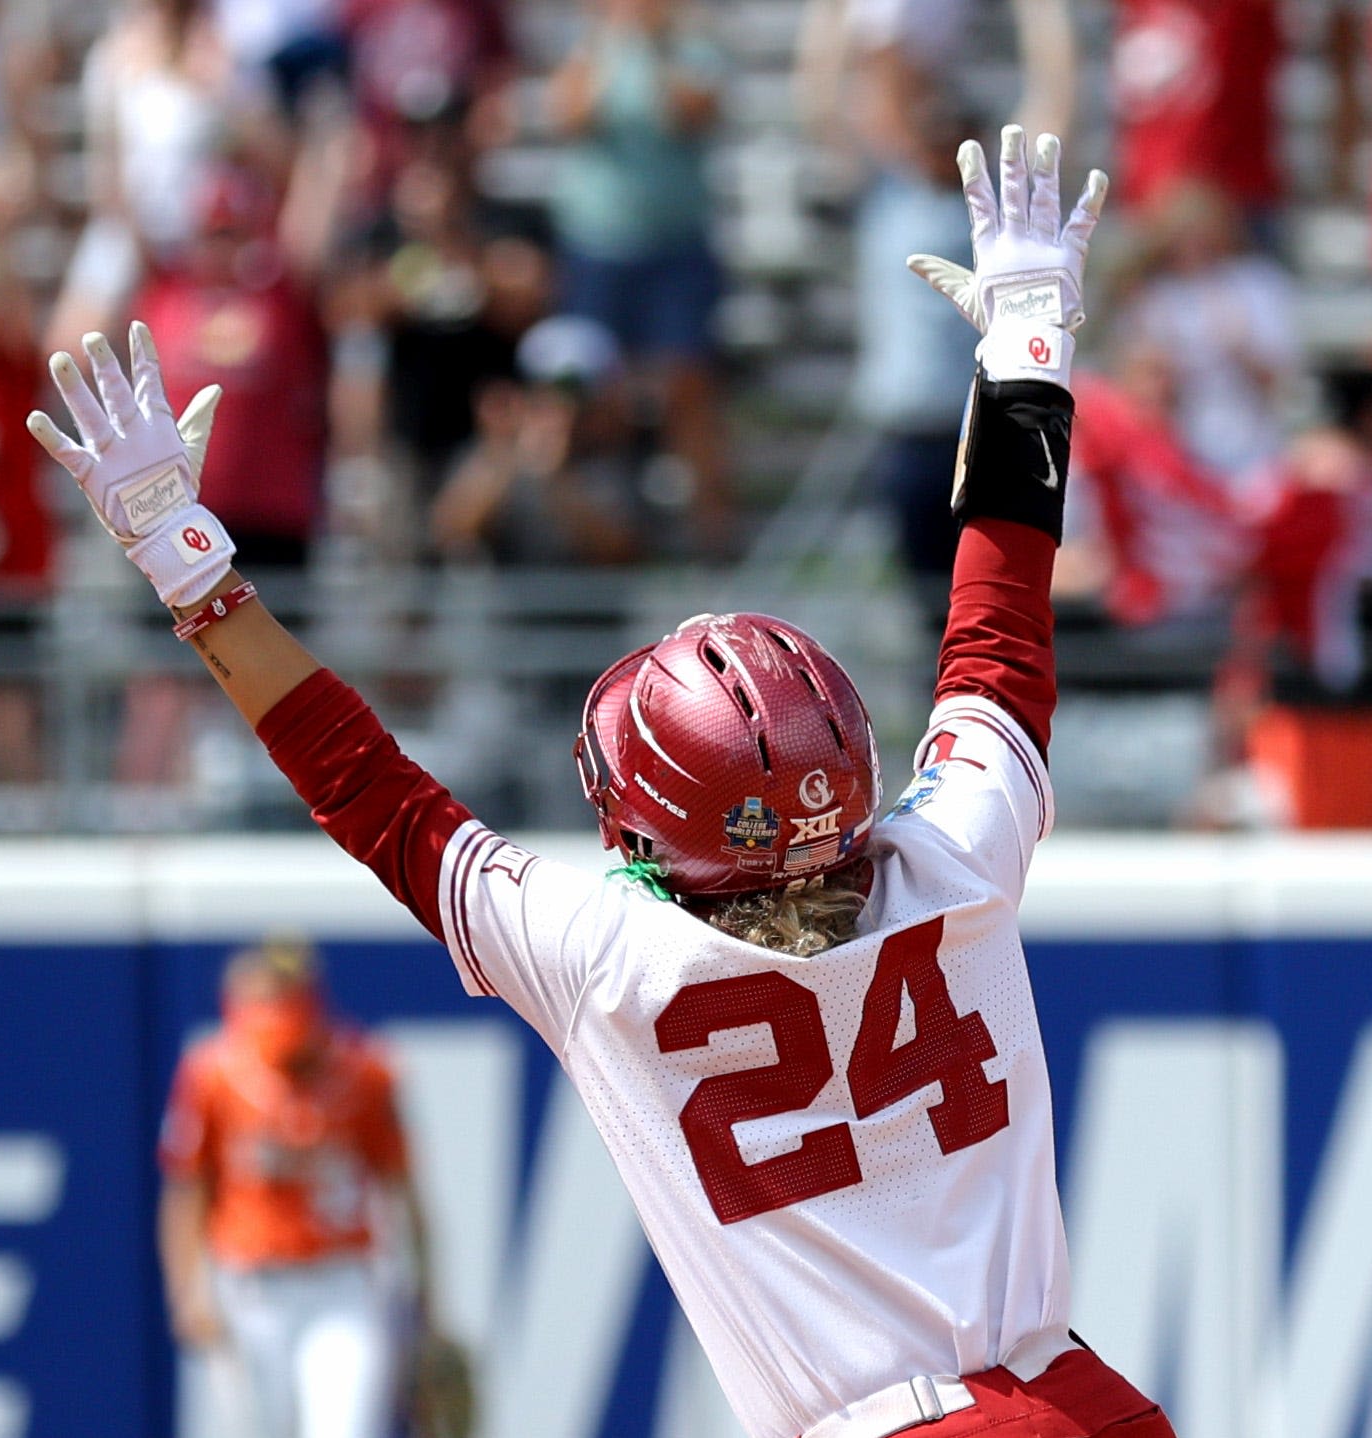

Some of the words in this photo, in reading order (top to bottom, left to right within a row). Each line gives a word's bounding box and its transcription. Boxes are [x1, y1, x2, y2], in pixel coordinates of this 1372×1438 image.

[1029, 337, 1050, 364] OU
[182, 526, 212, 553] OU
[633, 772, 688, 821] RAWLINGS
[654, 915, 1010, 1226] 24
